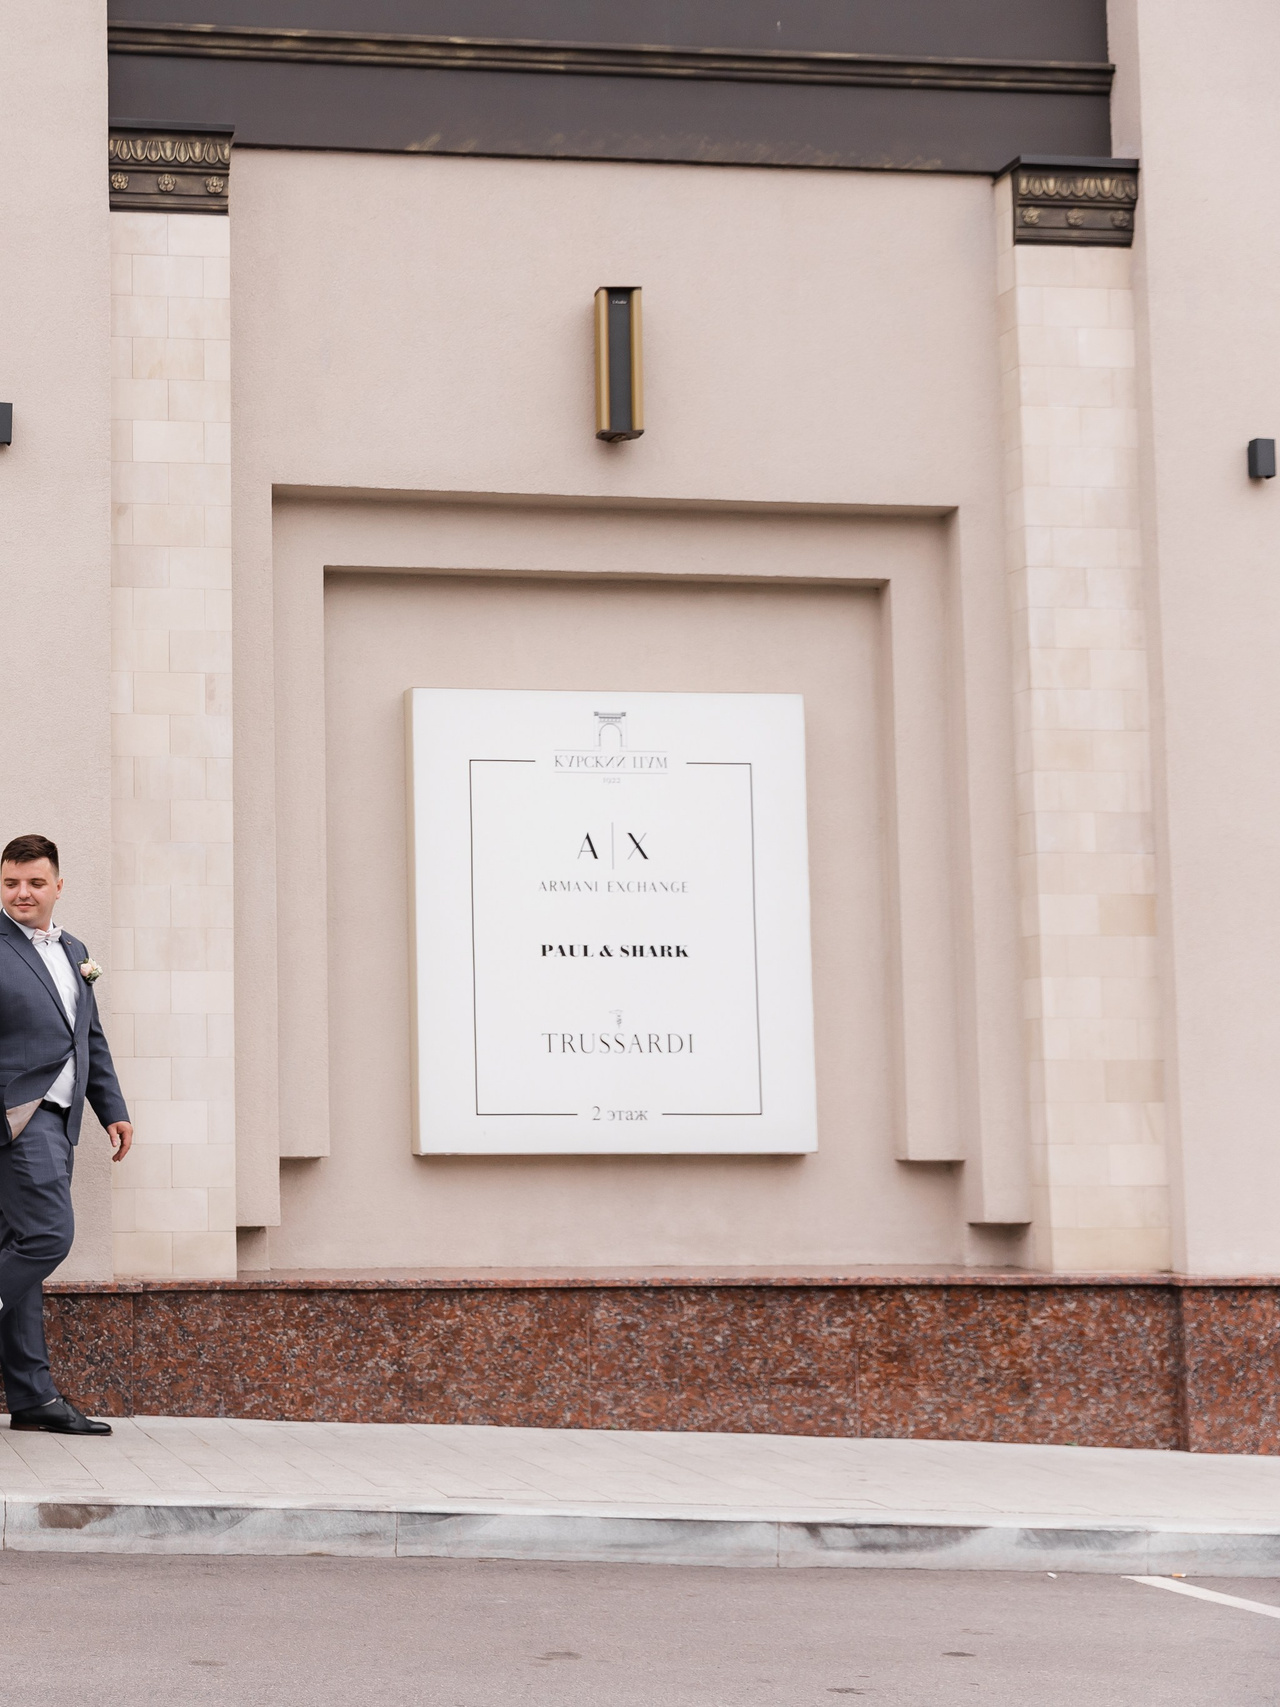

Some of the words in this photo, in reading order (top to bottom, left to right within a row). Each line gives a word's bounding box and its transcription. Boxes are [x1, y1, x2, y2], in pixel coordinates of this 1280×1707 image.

[633, 756, 668, 769] ЦУМ
[538, 880, 599, 892] ARMANI
[607, 880, 689, 893] EXCHANGE
[541, 944, 594, 957] PAUL
[599, 944, 614, 957] &
[620, 944, 689, 958] SHARK
[541, 1032, 695, 1054] TRUSSARDI
[592, 1105, 601, 1121] 2
[607, 1110, 648, 1121] этаж
